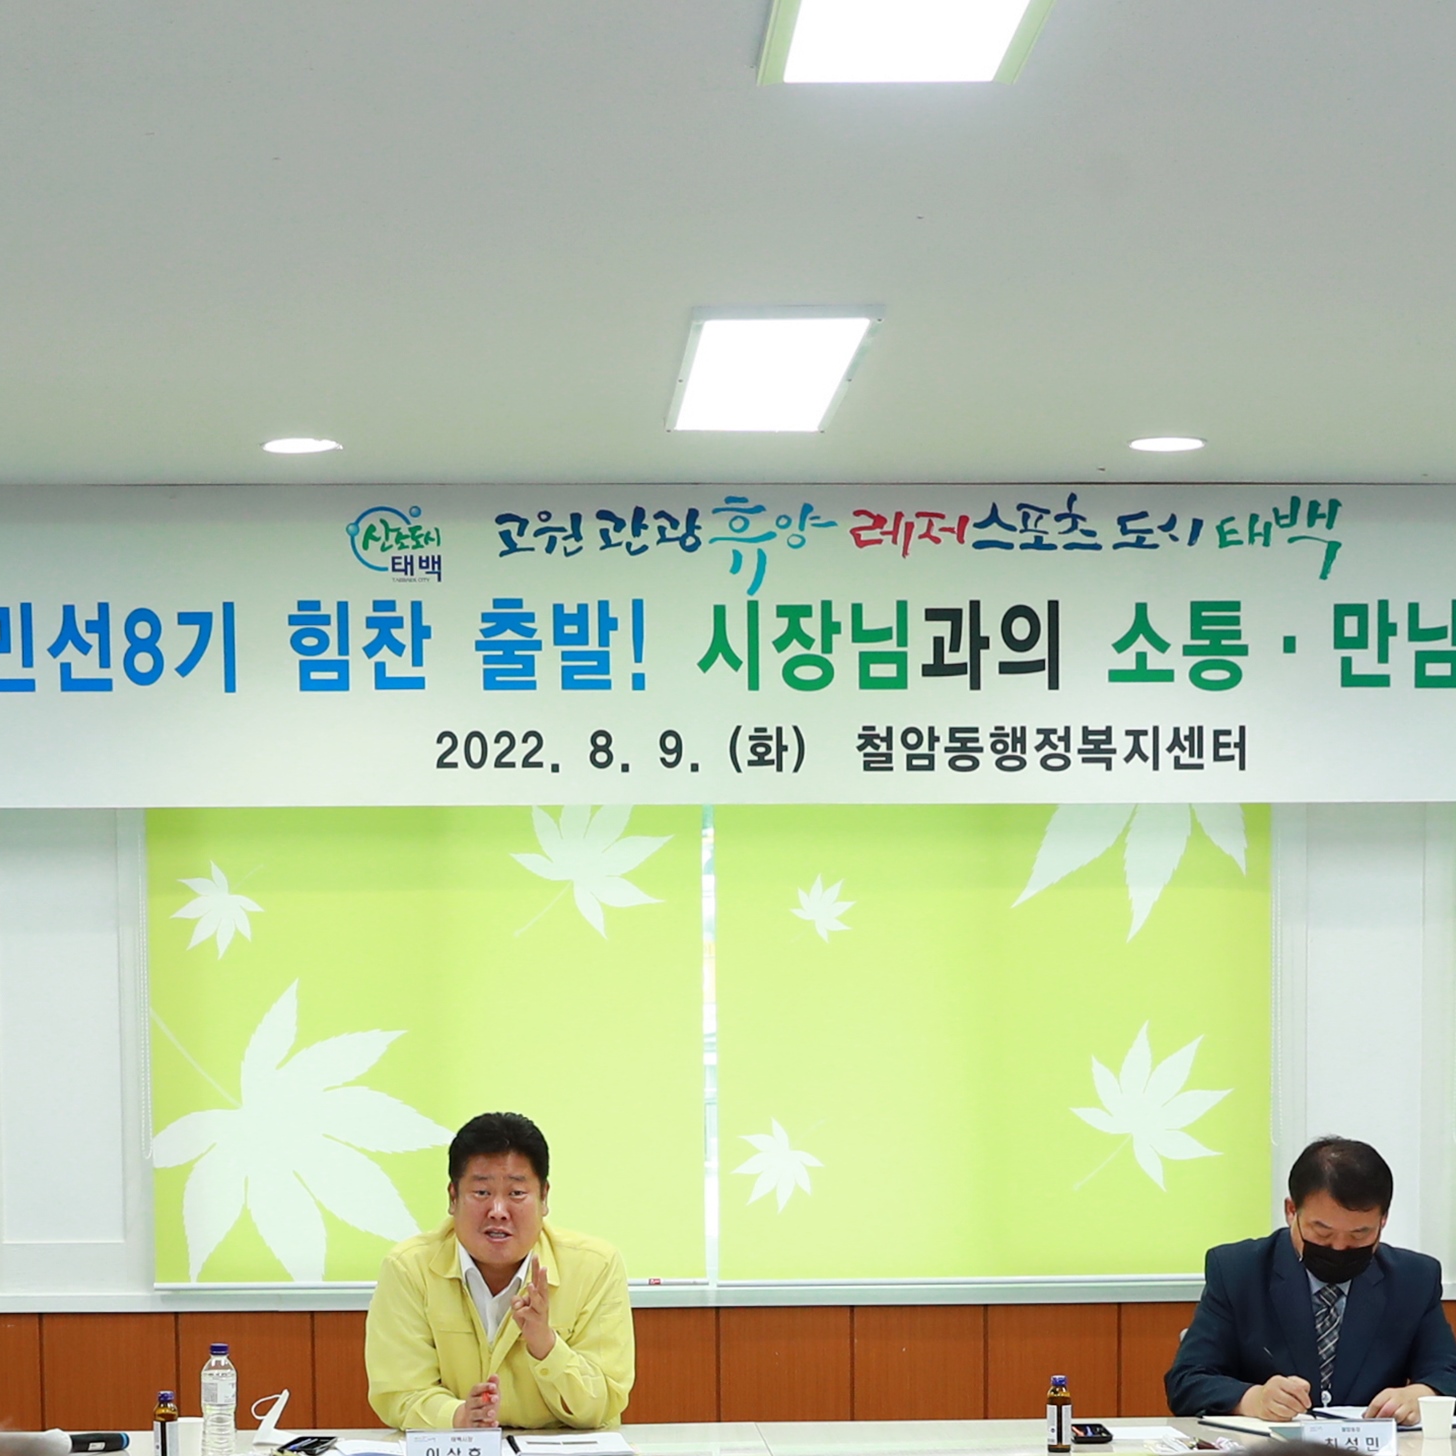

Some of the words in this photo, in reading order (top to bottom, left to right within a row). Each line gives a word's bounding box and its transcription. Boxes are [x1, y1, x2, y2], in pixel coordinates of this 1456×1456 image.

[391, 555, 442, 582] 태백
[495, 509, 583, 557] 고원
[596, 505, 702, 556] 관광
[709, 495, 839, 596] 휴양
[1112, 510, 1203, 550] 도시
[1216, 495, 1342, 580] 태백
[287, 599, 432, 692] 힘찬
[474, 597, 646, 692] 출발!
[696, 599, 1060, 692] 시장님과의
[1107, 599, 1249, 692] 소통
[435, 729, 560, 774] 2022.
[589, 729, 630, 773] 8.
[658, 729, 700, 773] 9.
[729, 724, 806, 774] (화)
[855, 724, 1247, 773] 철암동행정복지센터
